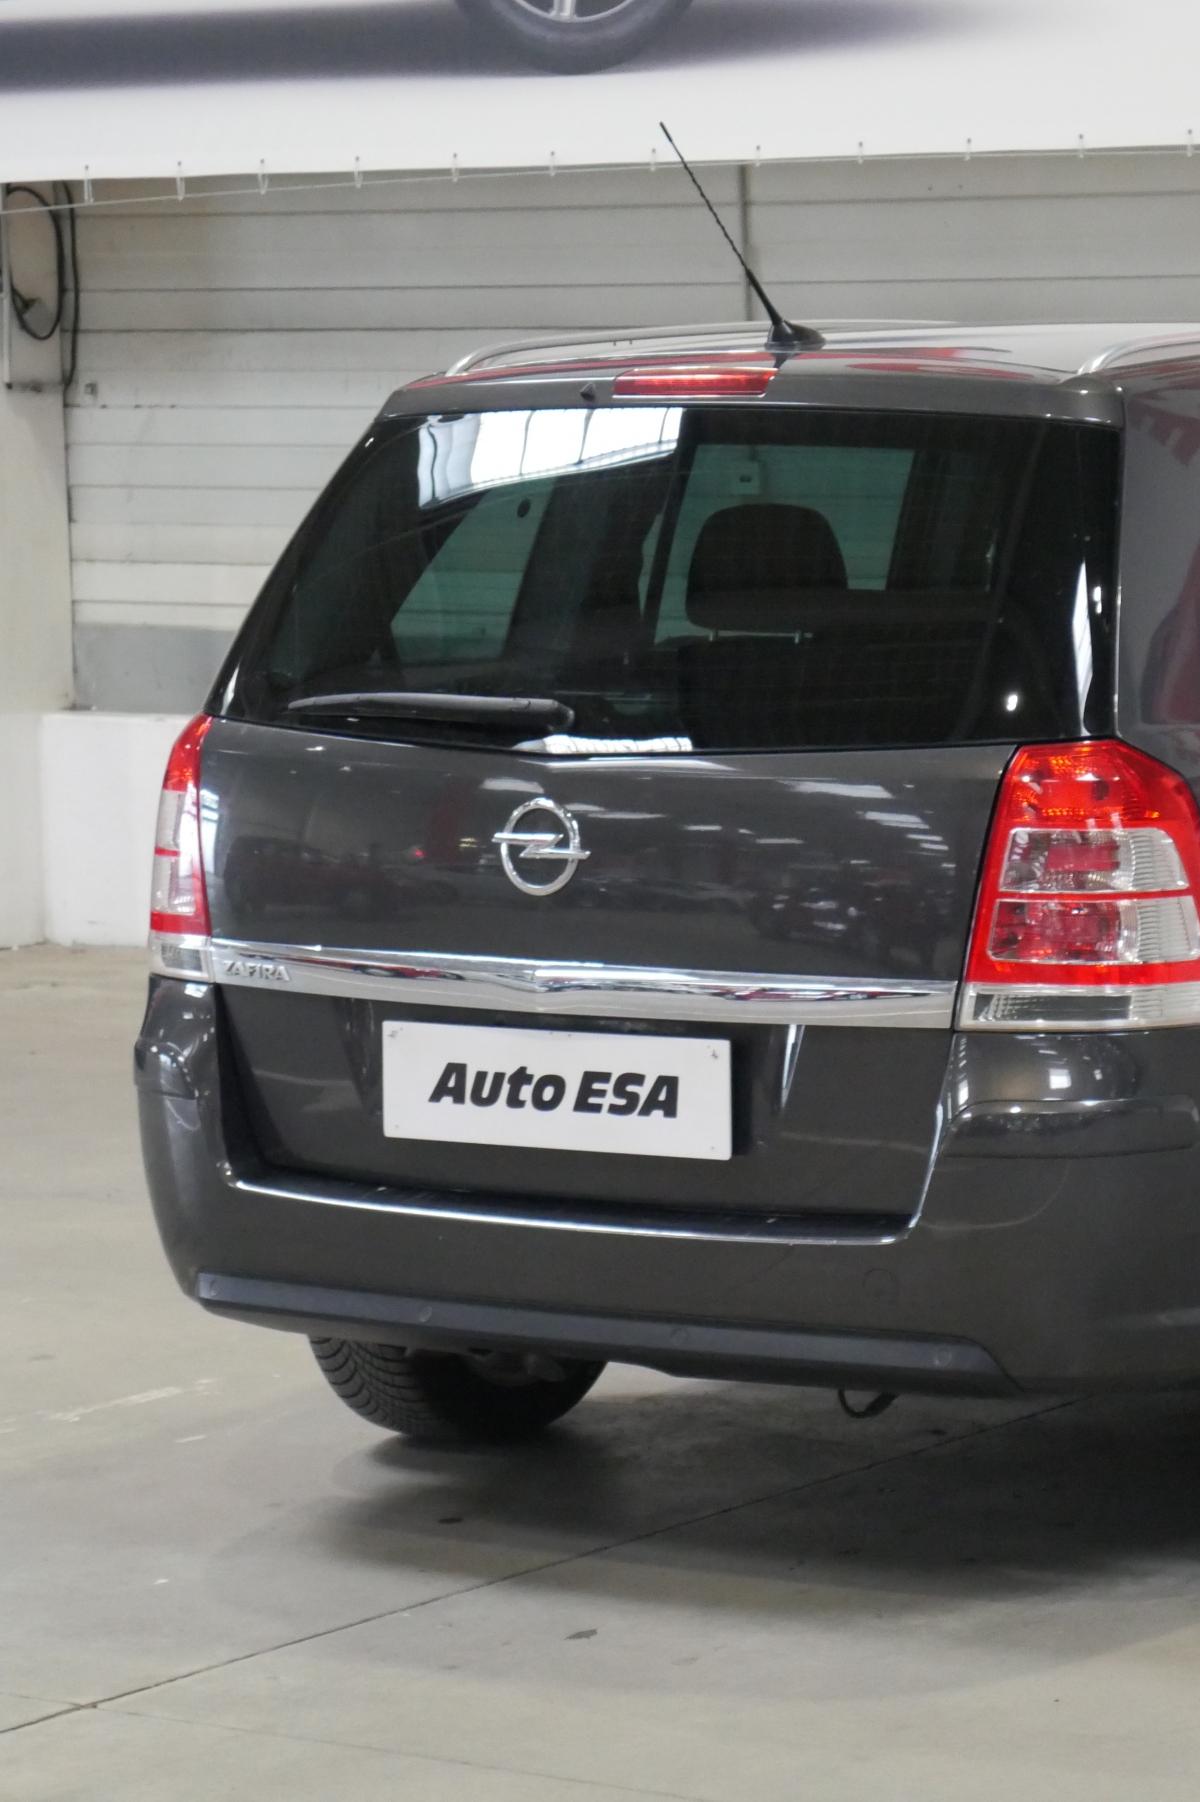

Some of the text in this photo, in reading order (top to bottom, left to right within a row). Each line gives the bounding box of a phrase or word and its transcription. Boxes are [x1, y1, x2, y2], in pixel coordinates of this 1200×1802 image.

[224, 960, 290, 981] ZAFIRA
[428, 1062, 680, 1119] Auto ESA
